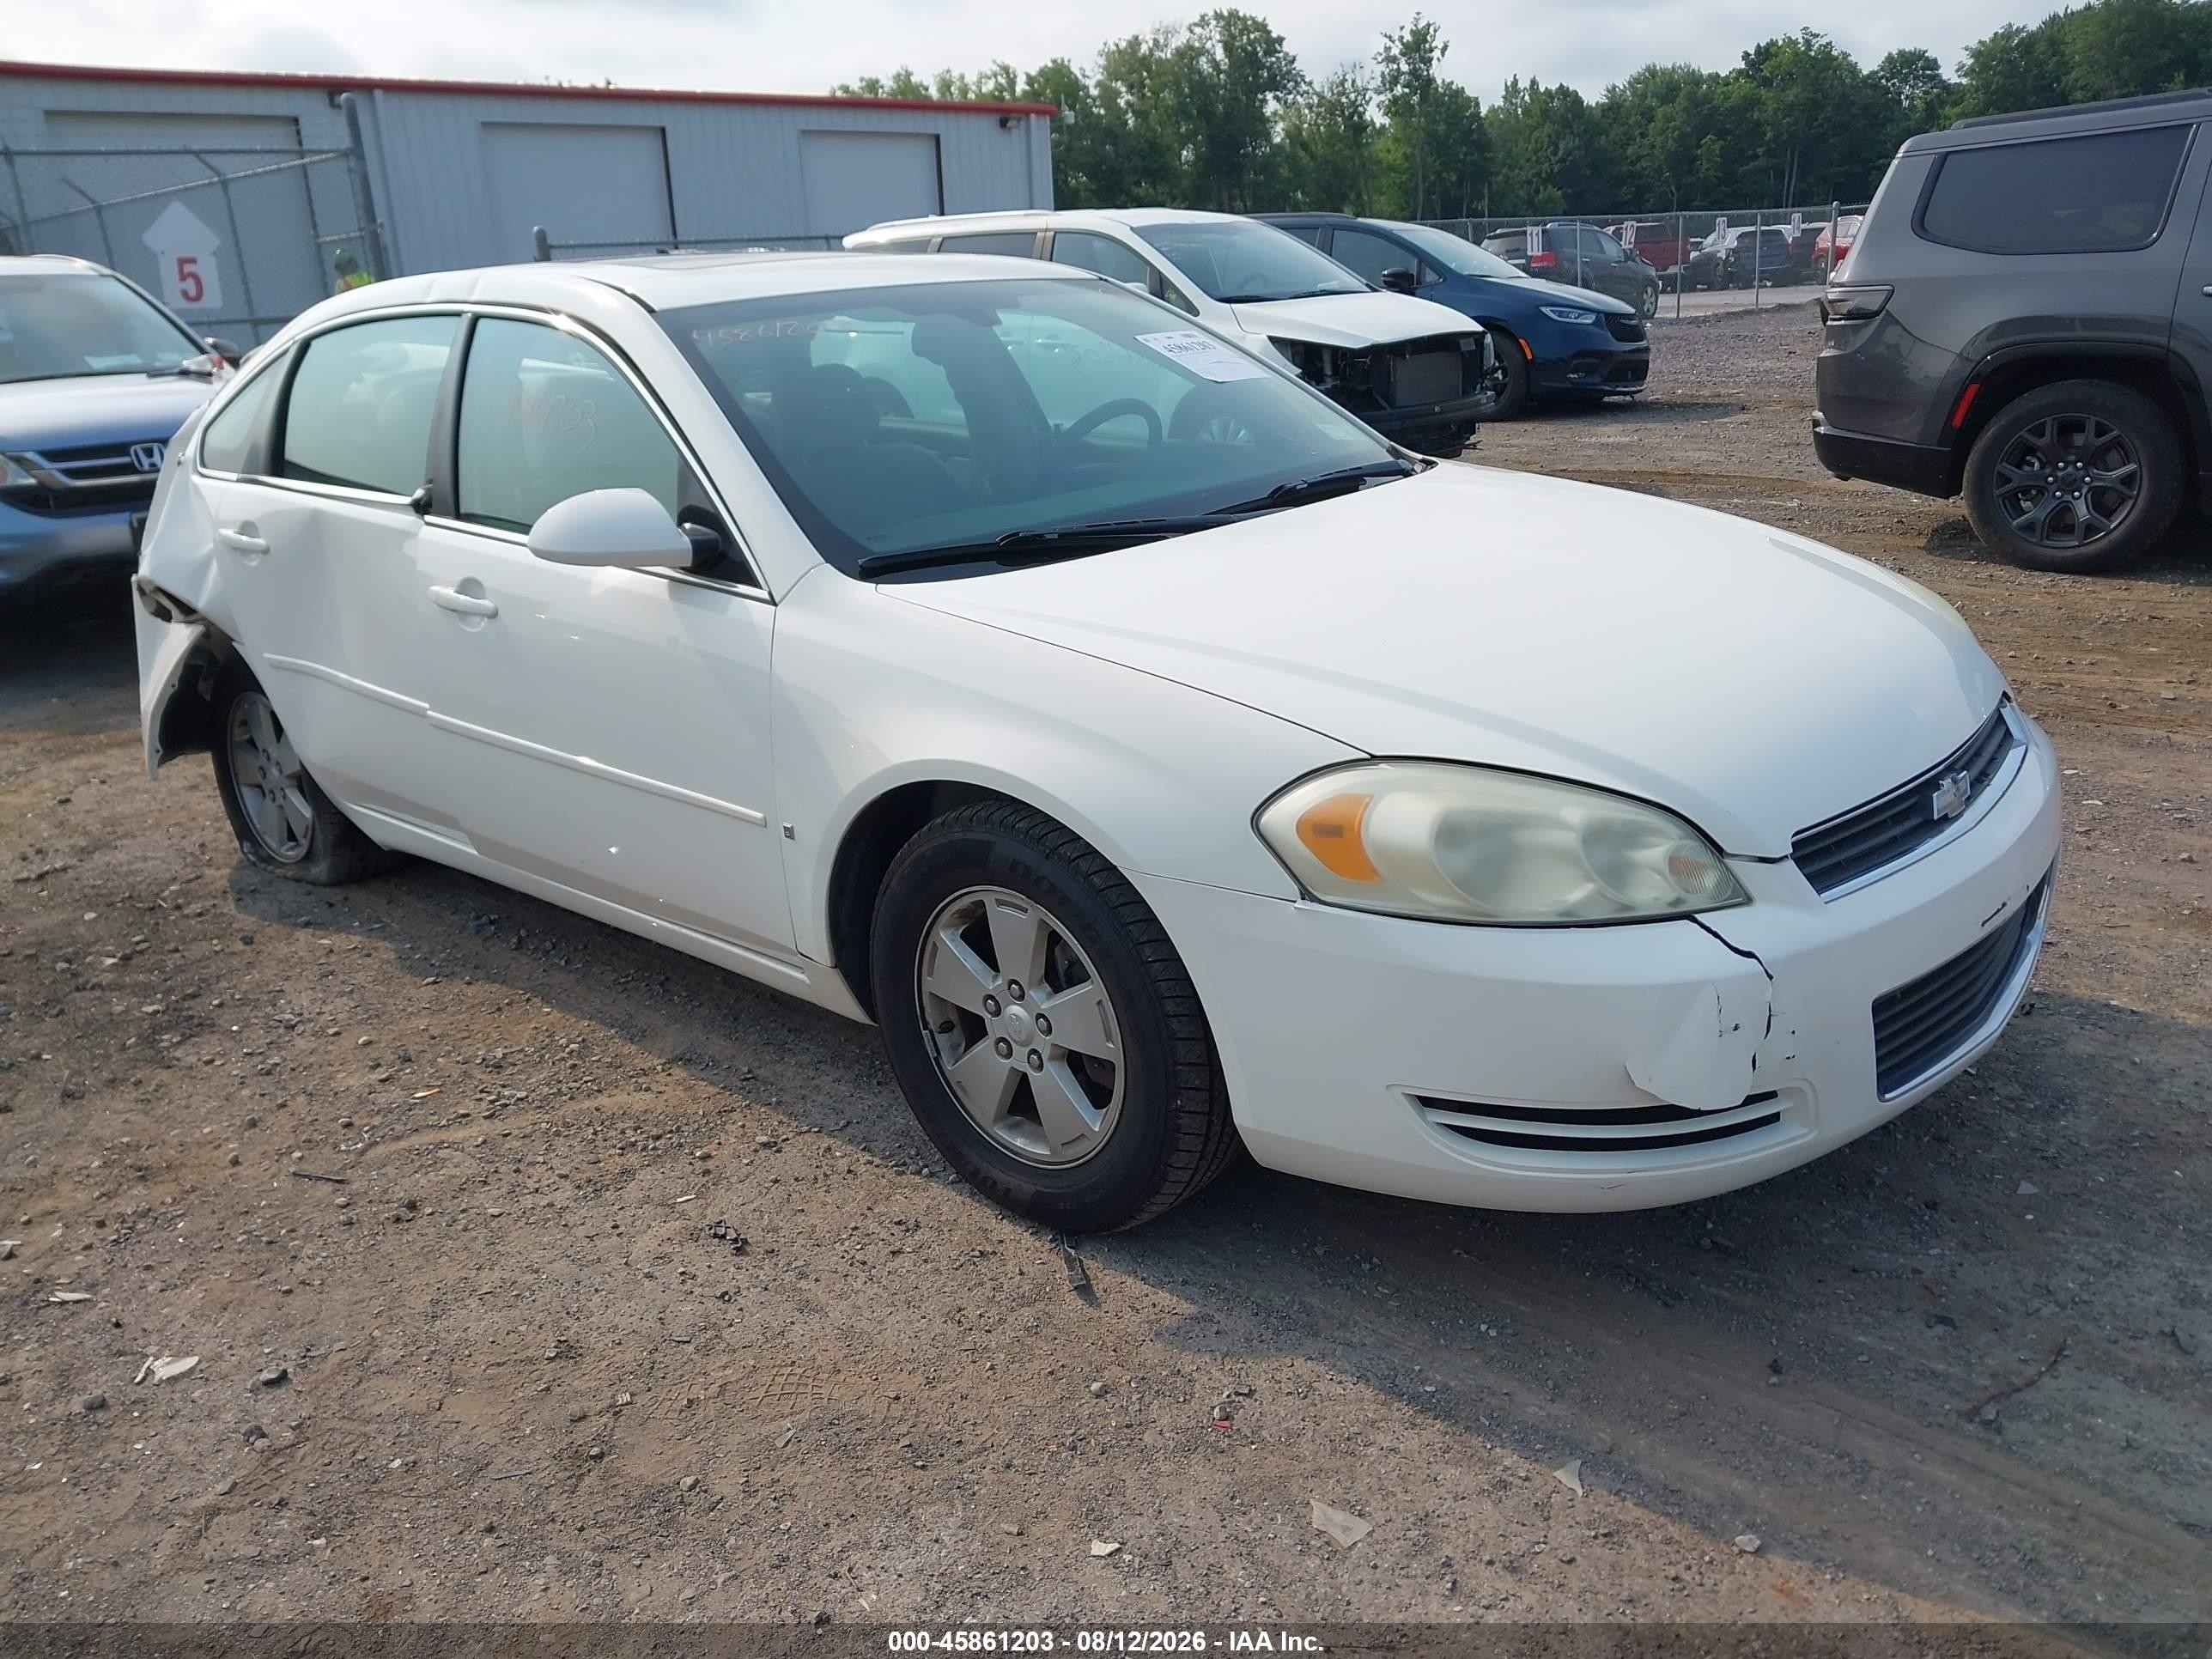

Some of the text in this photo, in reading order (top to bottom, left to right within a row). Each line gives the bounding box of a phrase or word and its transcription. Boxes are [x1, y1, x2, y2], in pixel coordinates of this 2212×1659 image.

[1528, 228, 1540, 253] 11
[1623, 222, 1637, 246] 12
[1717, 219, 1727, 240] 13
[176, 256, 204, 303] 5
